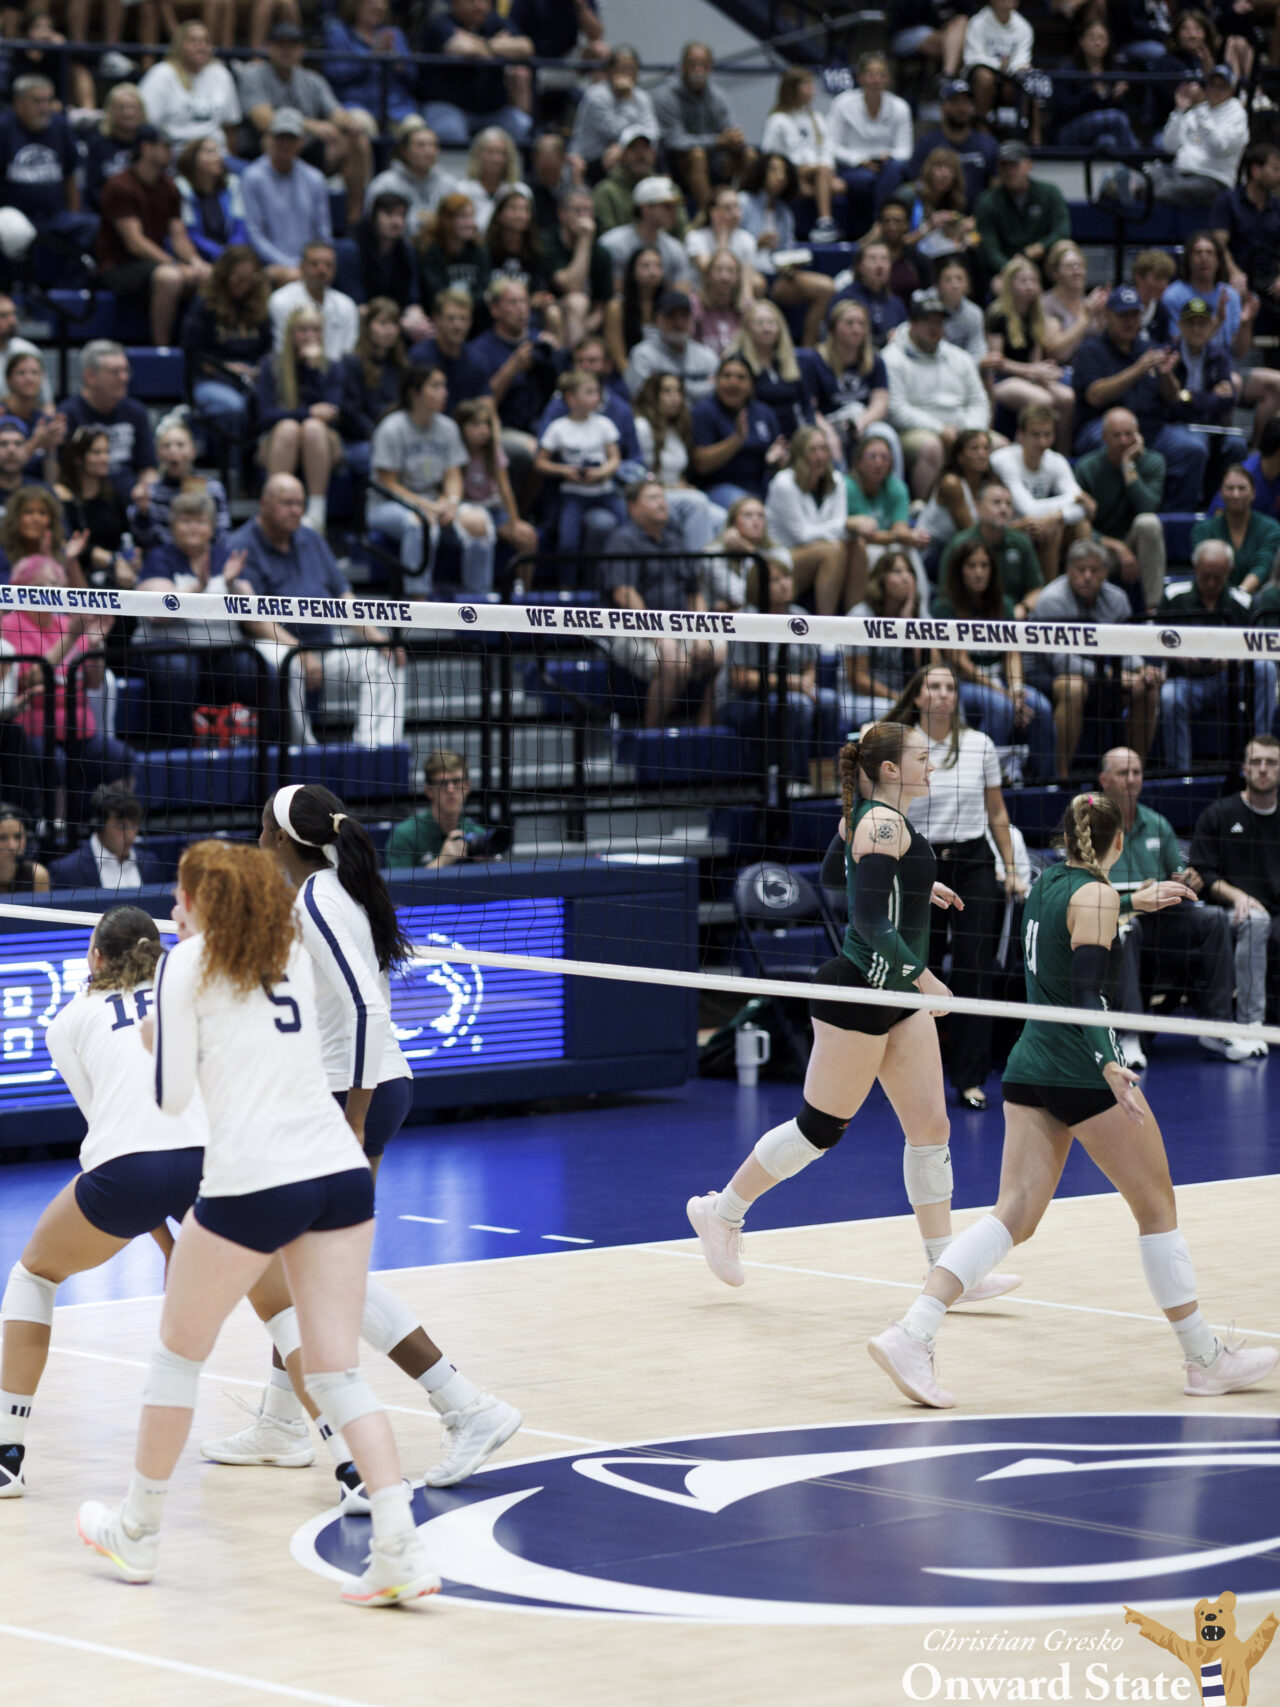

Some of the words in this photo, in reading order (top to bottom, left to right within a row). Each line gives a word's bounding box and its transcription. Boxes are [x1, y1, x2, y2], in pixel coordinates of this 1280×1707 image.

[17, 588, 63, 606] PENN
[68, 590, 121, 609] STATE
[224, 596, 252, 614] WE
[257, 597, 294, 616] ARE
[298, 599, 348, 619] PENN
[352, 601, 412, 621] STATE
[526, 608, 557, 627] WE
[563, 609, 603, 629] ARE
[608, 611, 664, 631] PENN
[669, 613, 736, 634] STATE
[863, 620, 898, 639] WE
[904, 621, 949, 641] ARE
[956, 622, 1019, 644] PENN
[1024, 626, 1098, 647] STATE
[1243, 631, 1280, 653] WE
[269, 974, 302, 1033] 5
